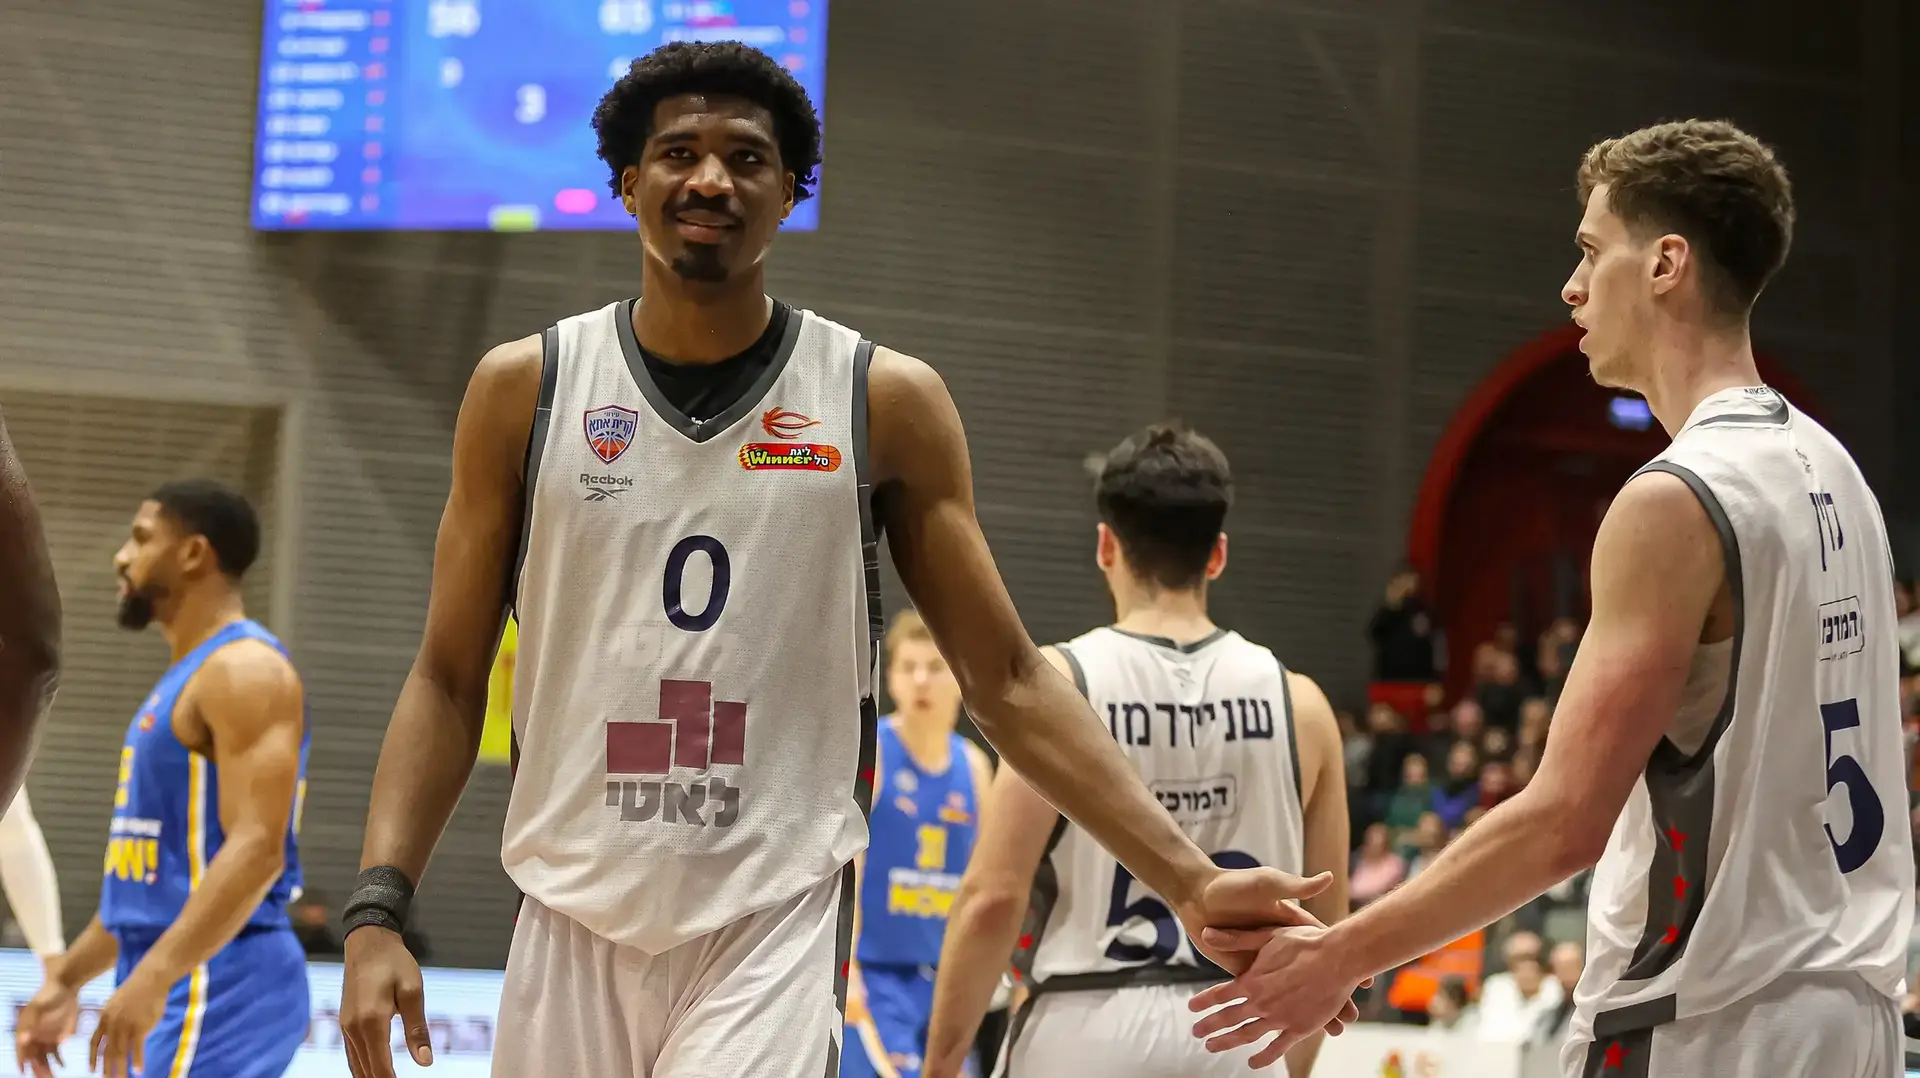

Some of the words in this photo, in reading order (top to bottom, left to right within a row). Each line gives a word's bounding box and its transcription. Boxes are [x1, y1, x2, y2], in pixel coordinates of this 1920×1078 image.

[589, 418, 611, 436] אתא
[612, 418, 634, 438] קרית
[789, 446, 811, 456] ליגת
[813, 454, 829, 466] סל
[579, 473, 634, 487] Reebok
[662, 534, 731, 632] 0
[1821, 611, 1858, 645] המרכז
[1107, 697, 1275, 748] שניידרמן
[1820, 697, 1885, 875] 5
[605, 776, 740, 828] לאטי
